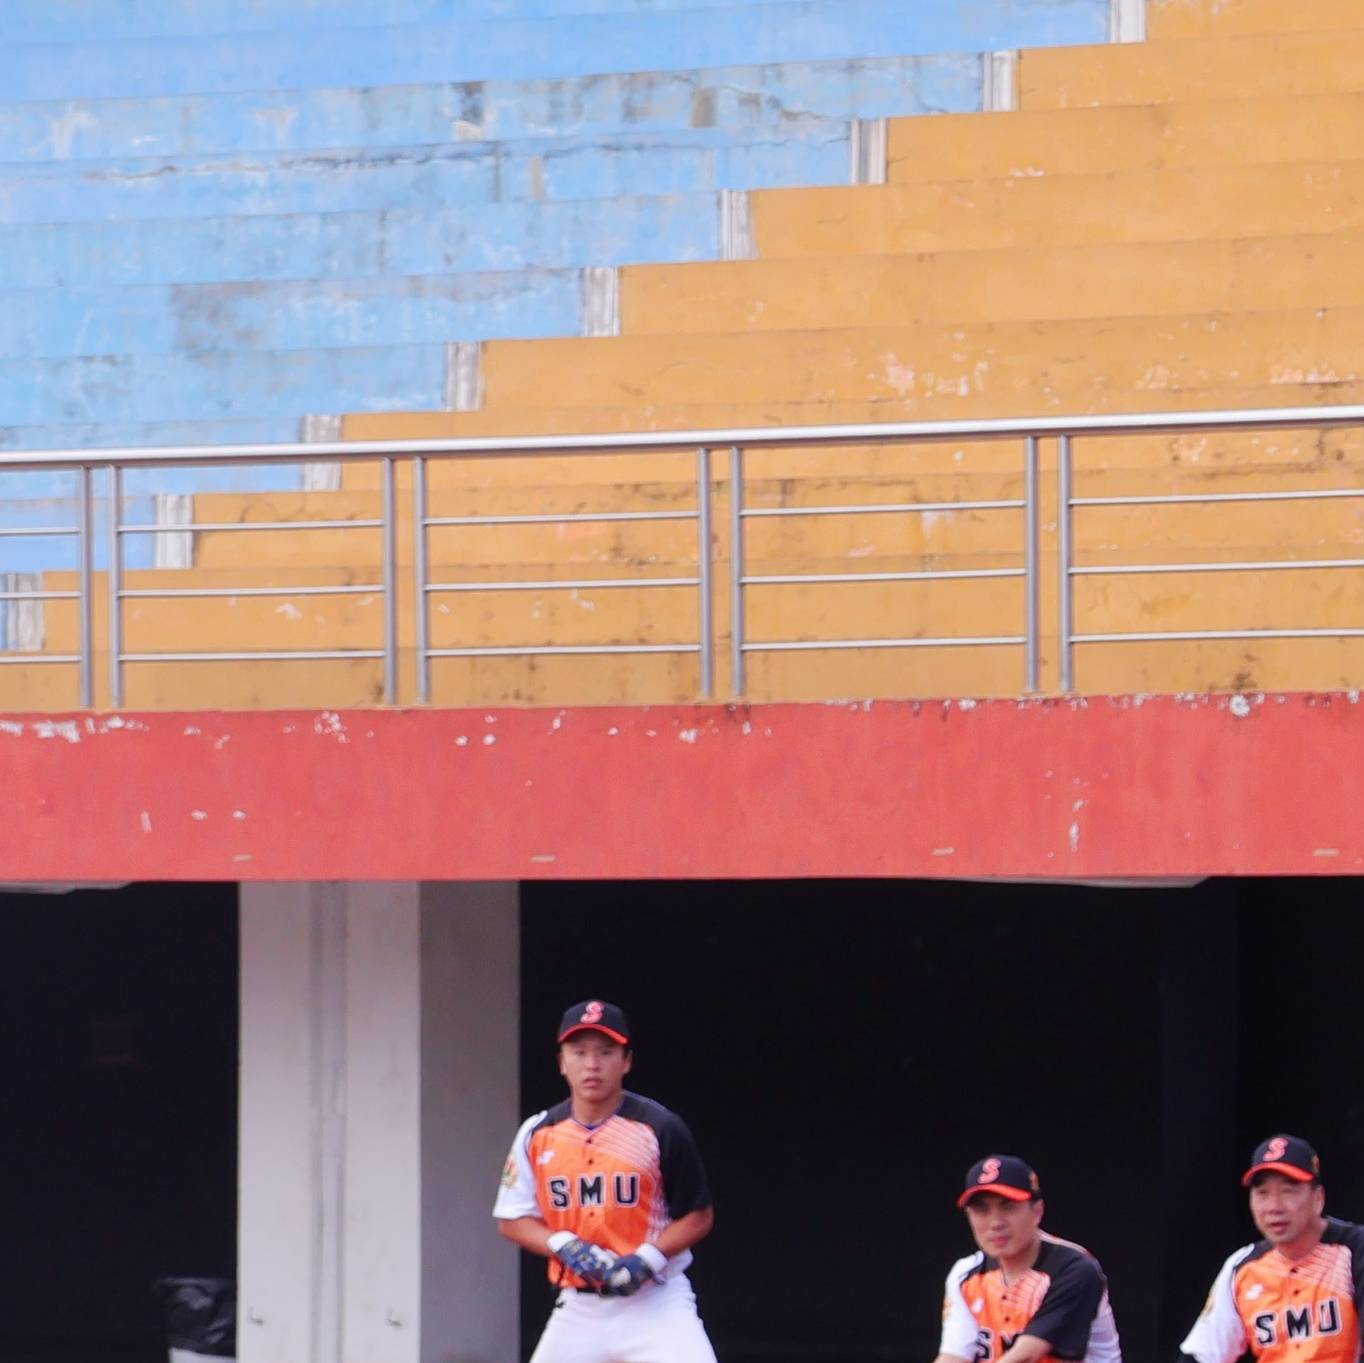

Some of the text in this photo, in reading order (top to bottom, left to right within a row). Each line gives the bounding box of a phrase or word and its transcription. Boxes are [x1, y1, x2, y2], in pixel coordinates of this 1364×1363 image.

[580, 1001, 604, 1024] S
[1263, 1137, 1288, 1161] S
[977, 1158, 1001, 1183] S
[548, 1173, 640, 1210] SMU
[1253, 1297, 1342, 1347] SMU
